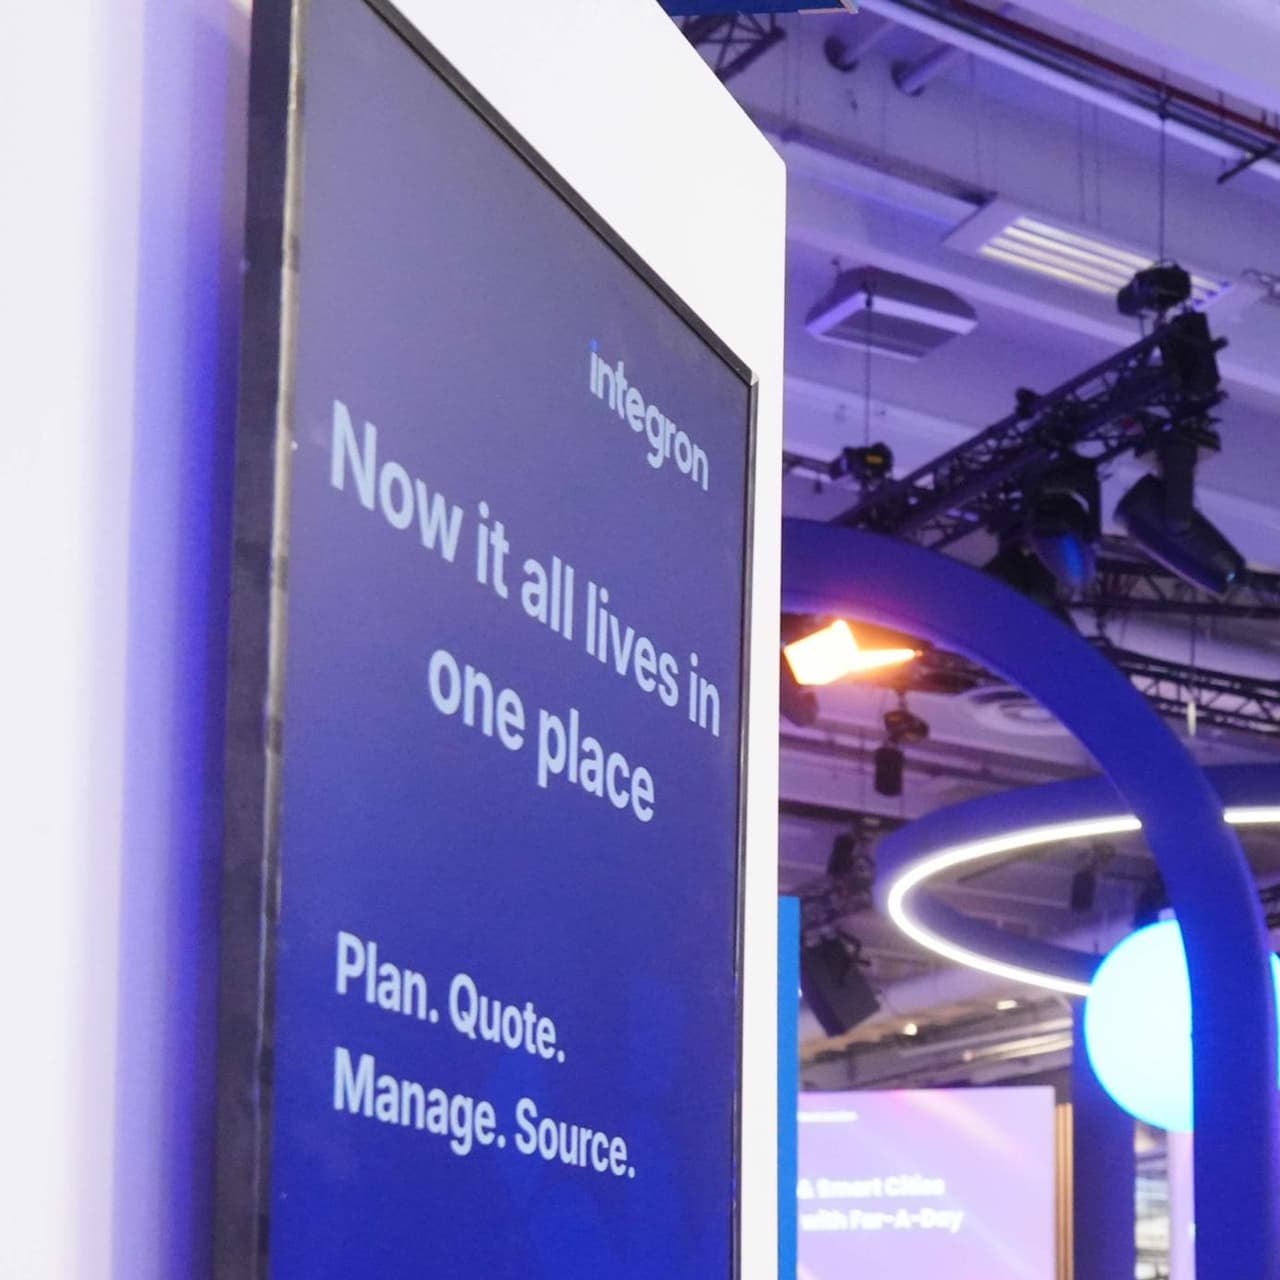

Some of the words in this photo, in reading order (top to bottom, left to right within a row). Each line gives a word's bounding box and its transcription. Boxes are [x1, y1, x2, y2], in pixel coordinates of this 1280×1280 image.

[590, 338, 708, 491] integron
[331, 399, 464, 562] Now
[477, 501, 510, 600] it
[521, 556, 575, 640] all
[586, 581, 679, 708] lives
[689, 652, 721, 737] in
[428, 649, 526, 751] one
[538, 708, 656, 822] place
[336, 930, 439, 1023] Plan.
[450, 973, 565, 1063] Quote.
[333, 1046, 506, 1156] Manage.
[515, 1097, 635, 1178] Source.
